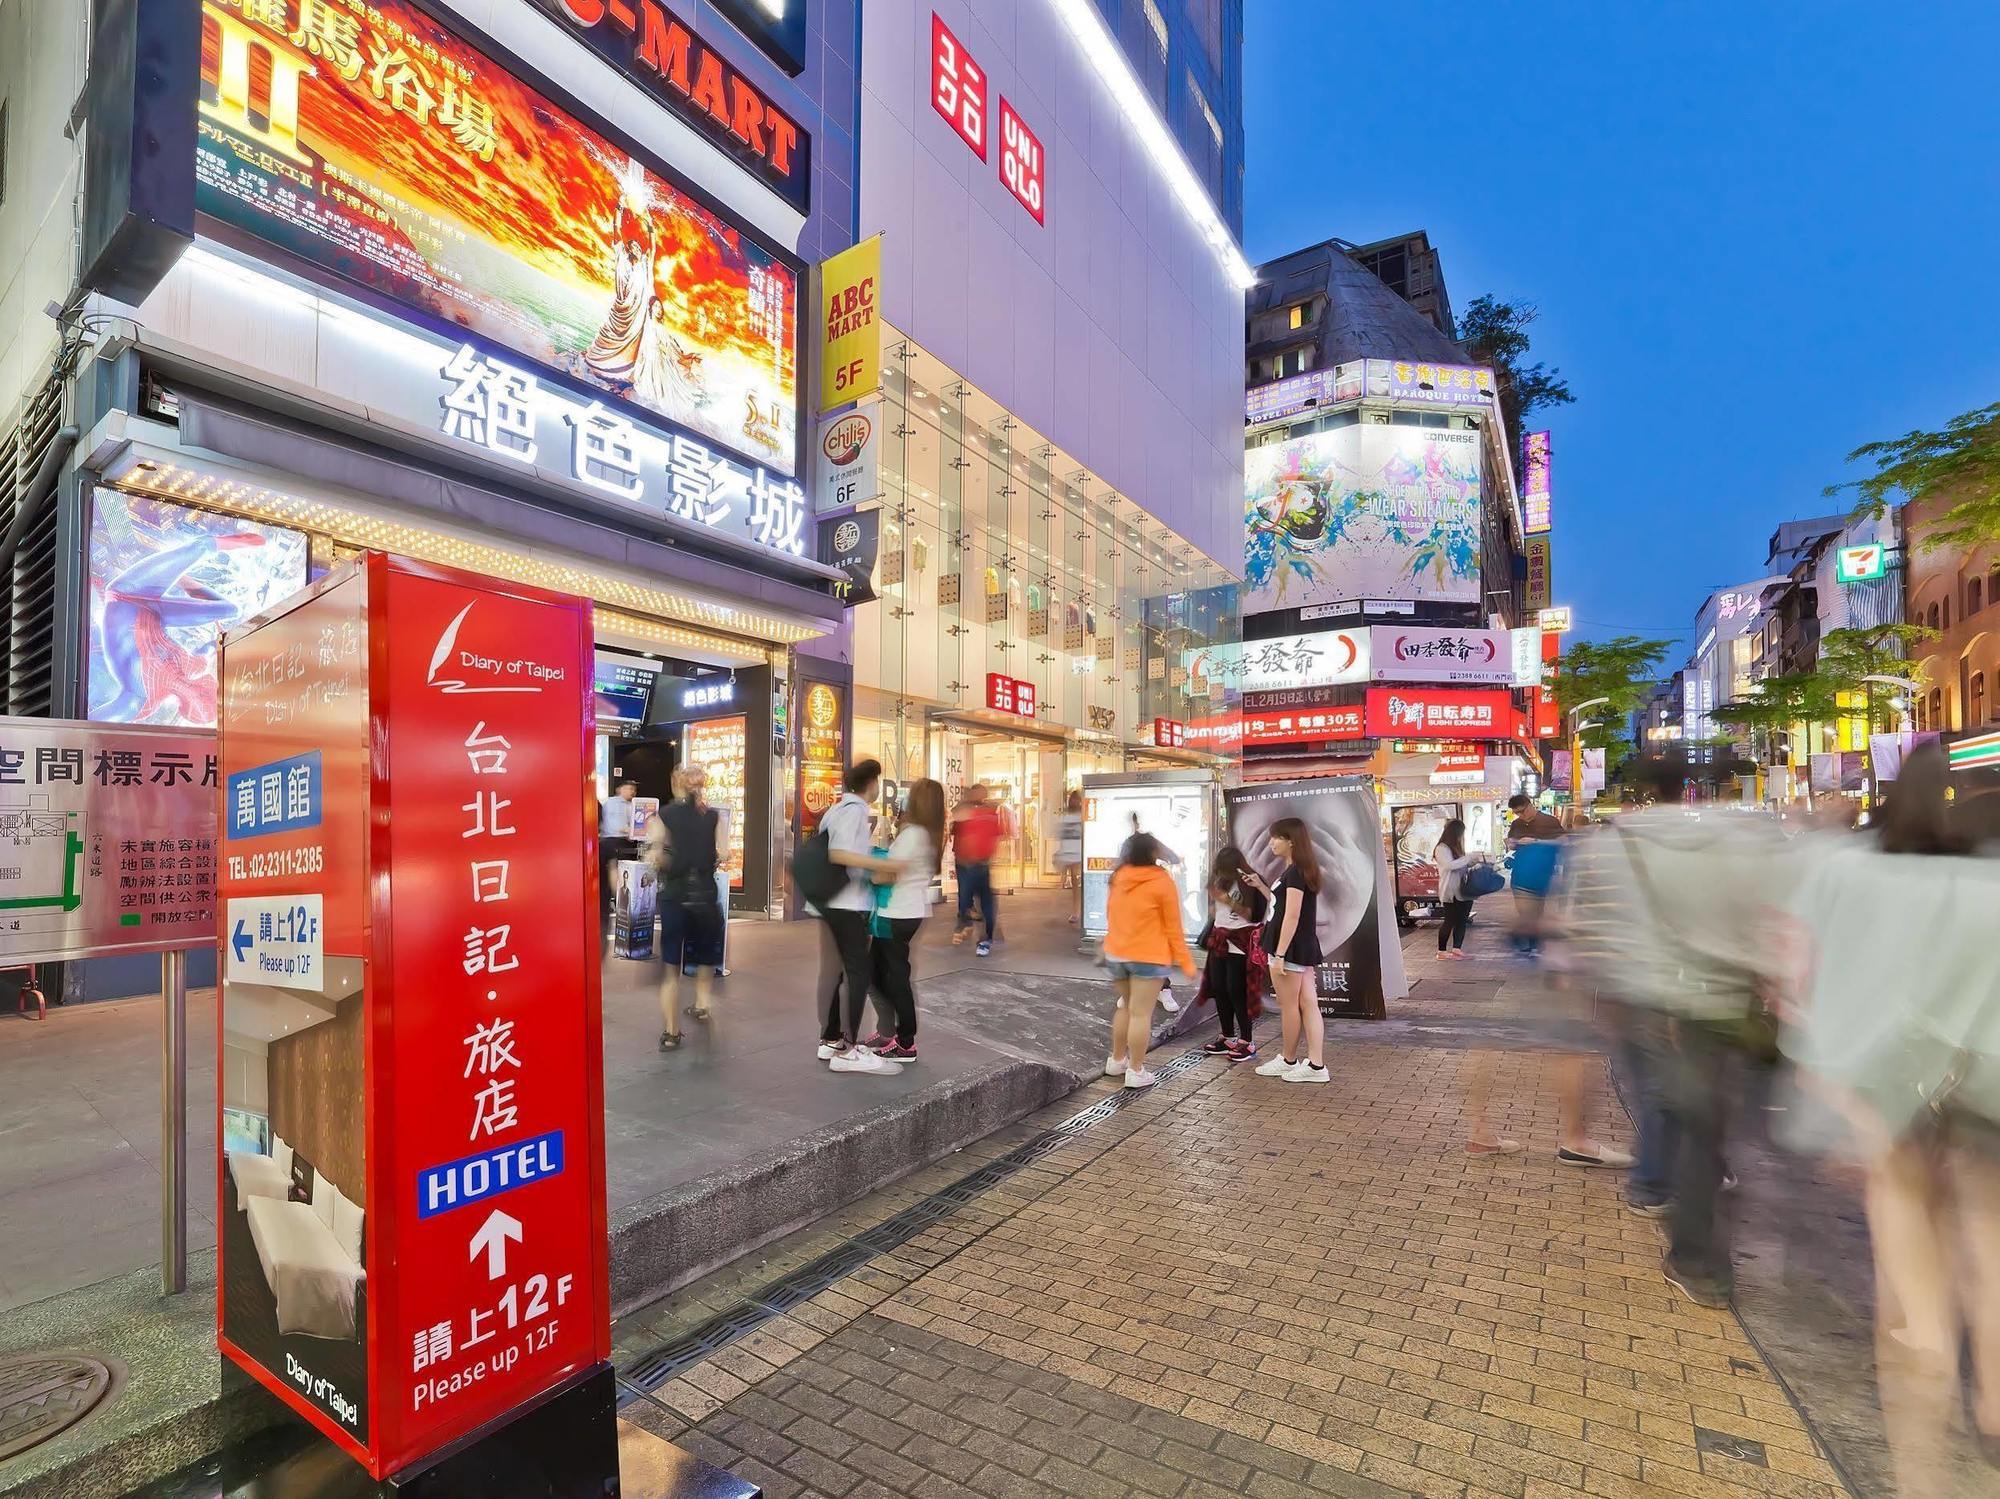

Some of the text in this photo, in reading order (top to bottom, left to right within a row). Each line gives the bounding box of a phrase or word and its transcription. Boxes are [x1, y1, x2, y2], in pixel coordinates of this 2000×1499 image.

[1004, 111, 1037, 176] UNI
[1004, 150, 1041, 211] QLO
[828, 276, 874, 324] ABC
[828, 306, 874, 343] MART
[836, 359, 864, 391] 5F
[1393, 388, 1449, 401] BAROQUE
[441, 344, 804, 555] 絕色影城
[1424, 433, 1475, 444] CONVERSE
[836, 483, 856, 504] 6F
[1369, 498, 1474, 518] WEAR SNEAKERS
[460, 651, 565, 681] Diary of Taipei
[265, 672, 349, 725] Diary of Taipei
[1453, 719, 1492, 727] EXPRESS
[236, 764, 311, 829] 萬國館
[120, 839, 217, 853] 未實施容積
[120, 855, 217, 871] 地區綜合設
[120, 873, 217, 889] 勵辦法設置
[120, 889, 217, 907] 空間供公眾
[259, 953, 311, 978] Please up 12F
[428, 1140, 556, 1210] HOTEL
[414, 1320, 560, 1412] Please up 12F
[285, 1352, 357, 1426] Diary of Taipei
